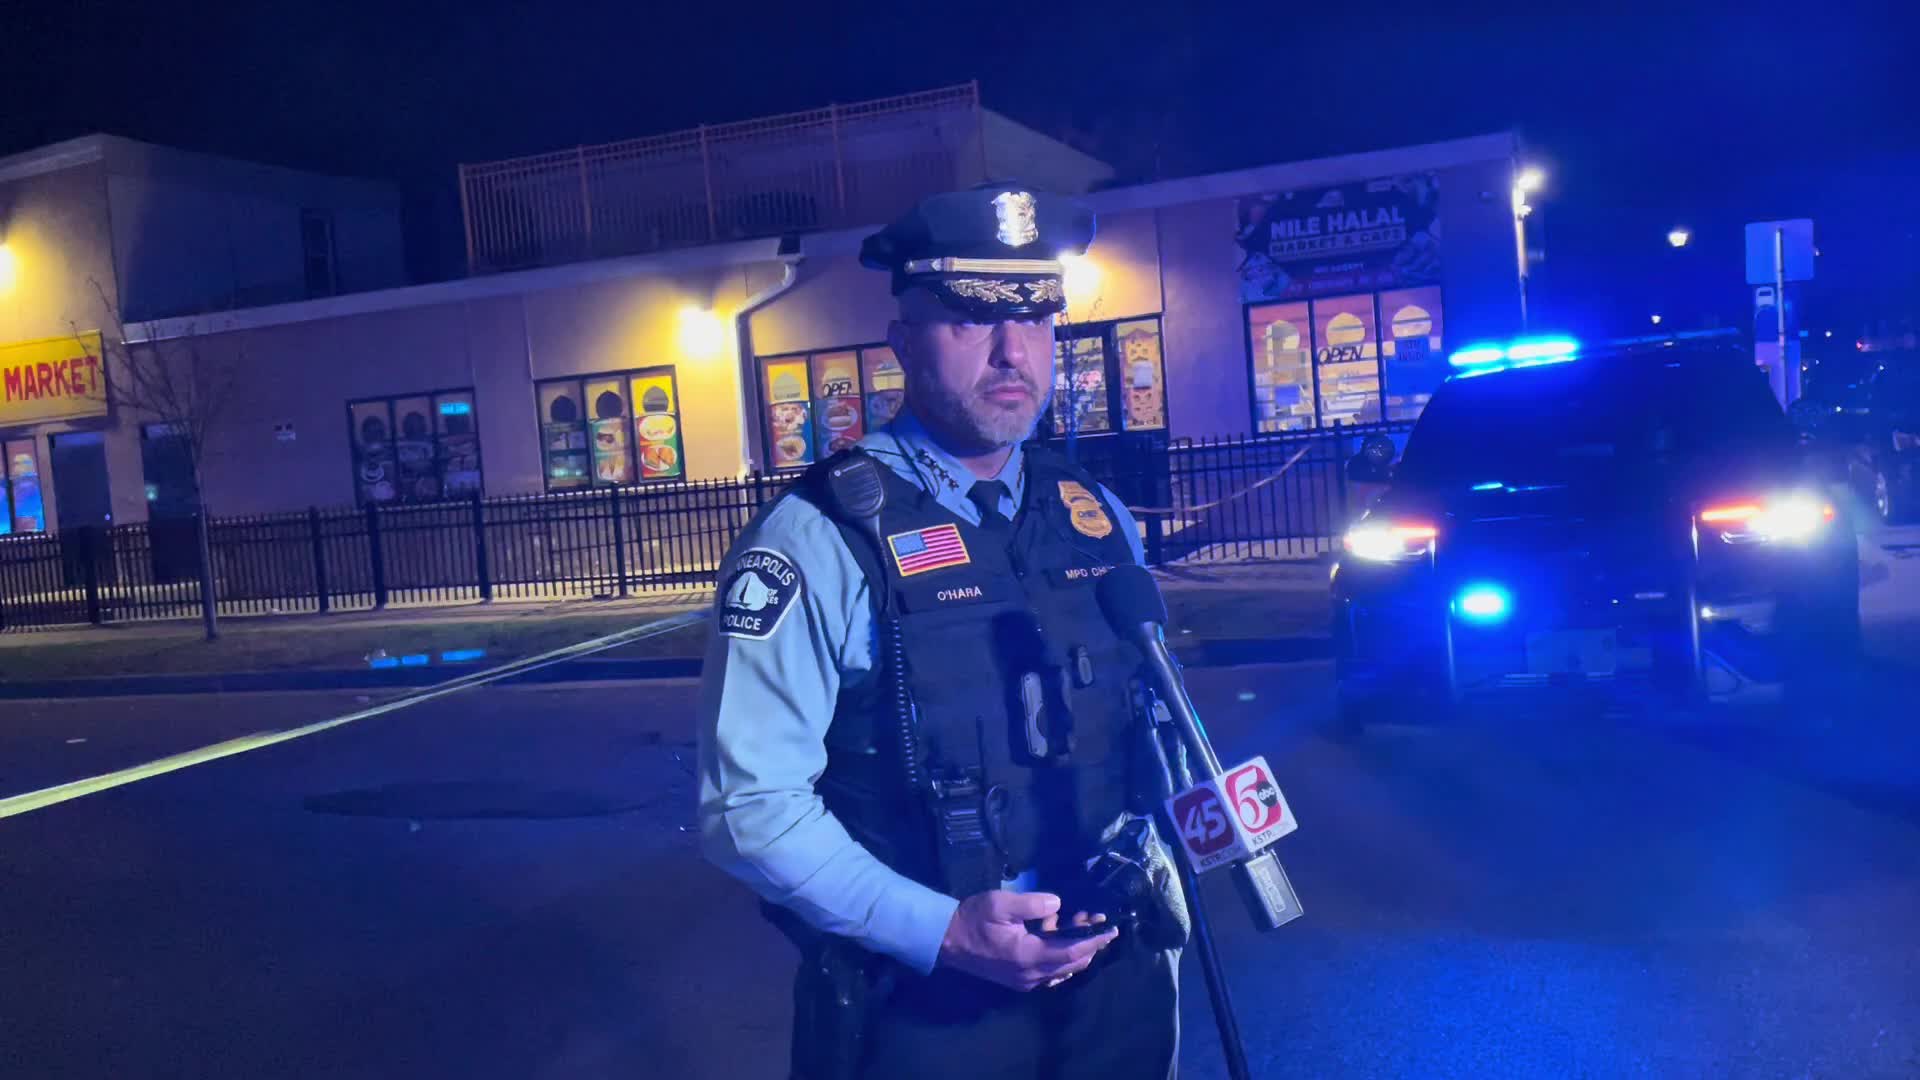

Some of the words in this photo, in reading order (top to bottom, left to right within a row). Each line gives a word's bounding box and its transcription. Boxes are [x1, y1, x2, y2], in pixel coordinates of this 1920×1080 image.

[1271, 217, 1321, 240] NILE
[1328, 207, 1405, 232] HALAL
[1318, 346, 1363, 365] OPEN
[4, 355, 98, 402] MARKET
[1065, 568, 1088, 580] MPD
[937, 586, 982, 601] O'HARA
[723, 614, 762, 631] POLICE
[1258, 786, 1276, 802] abc
[1184, 797, 1227, 843] 45
